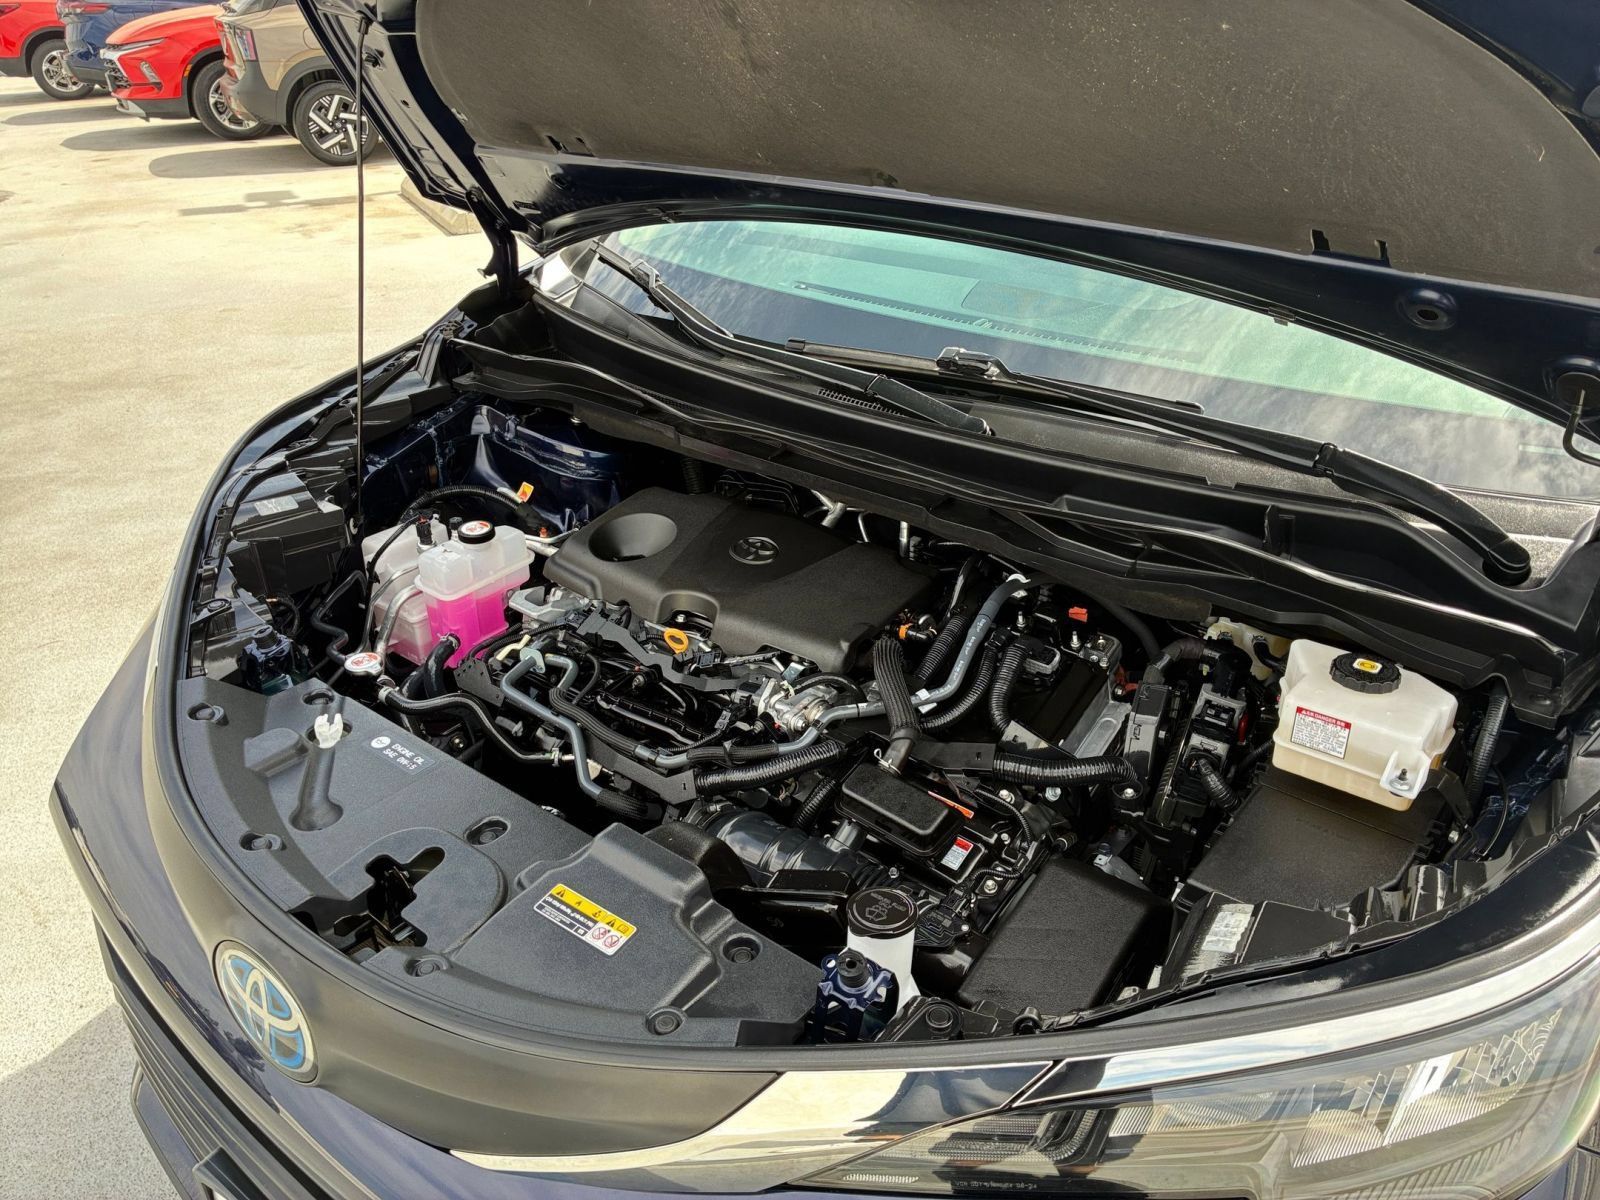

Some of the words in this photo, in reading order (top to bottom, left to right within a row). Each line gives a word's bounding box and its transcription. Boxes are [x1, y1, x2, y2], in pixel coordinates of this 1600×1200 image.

[1315, 711, 1336, 723] DANGER
[383, 748, 398, 758] SAE
[392, 743, 415, 758] ENGINE
[413, 756, 425, 765] OIL
